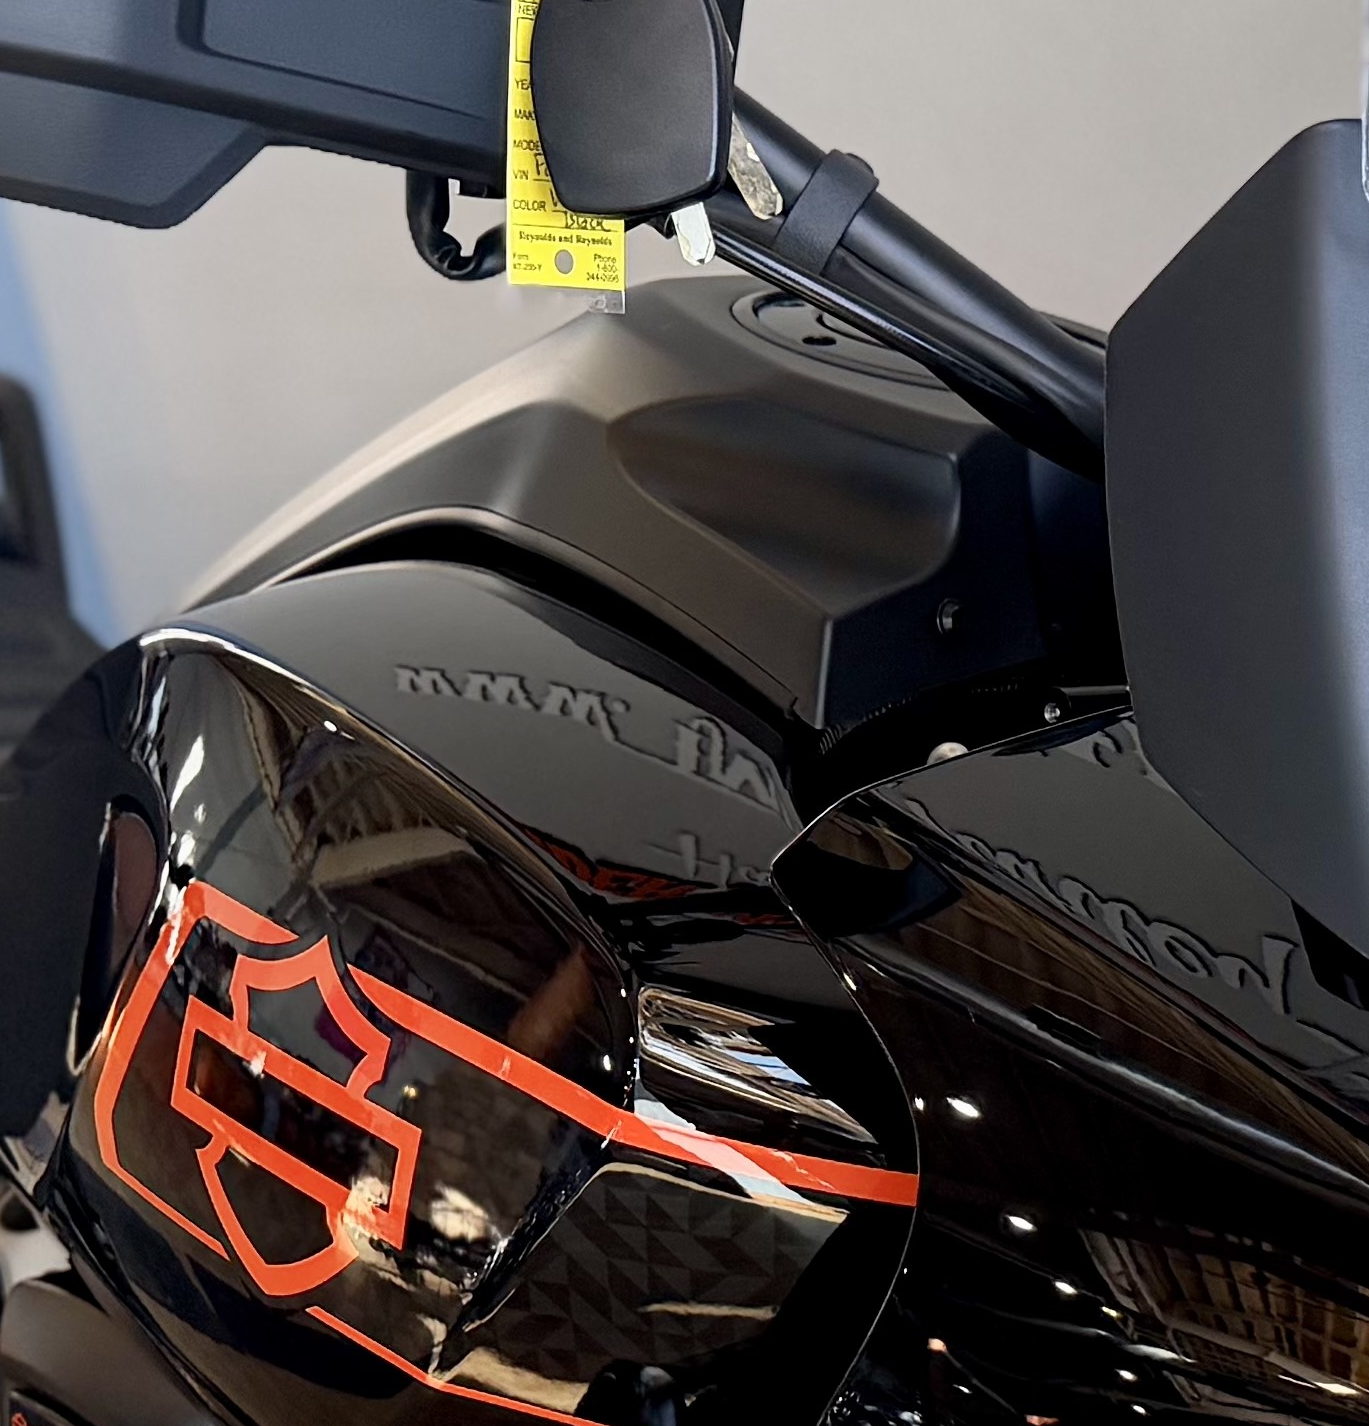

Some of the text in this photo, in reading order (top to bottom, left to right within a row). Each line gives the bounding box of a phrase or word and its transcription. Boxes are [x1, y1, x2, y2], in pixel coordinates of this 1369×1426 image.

[513, 168, 529, 181] VIN
[513, 199, 547, 213] COLOR
[519, 230, 613, 247] Reynolds and Reynolds
